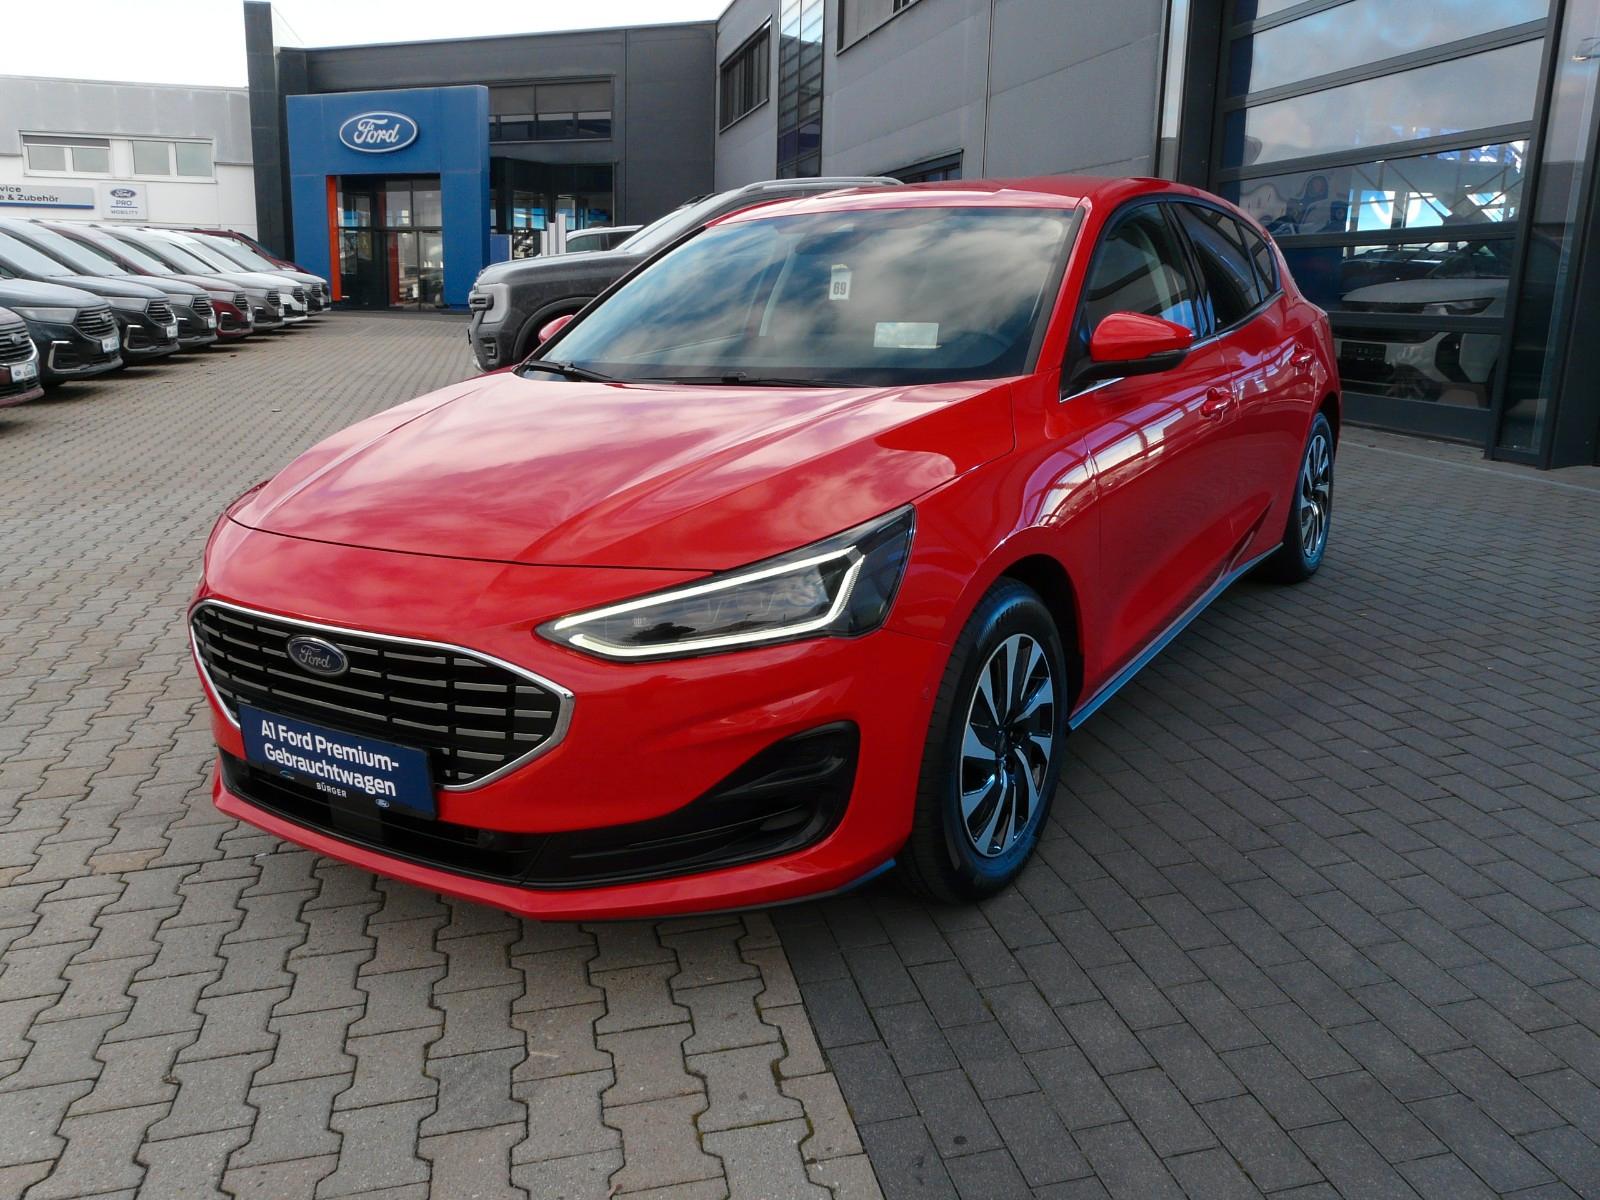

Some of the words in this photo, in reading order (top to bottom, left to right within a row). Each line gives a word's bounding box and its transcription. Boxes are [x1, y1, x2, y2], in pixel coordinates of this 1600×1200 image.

[353, 118, 400, 144] Ford
[17, 194, 59, 202] Zubehör
[299, 645, 331, 668] Ford
[261, 719, 276, 740] A1
[277, 724, 313, 751] Ford
[314, 734, 399, 772] Premium-
[264, 743, 397, 797] Gebrauchtwagen
[315, 782, 347, 798] BÜRGER
